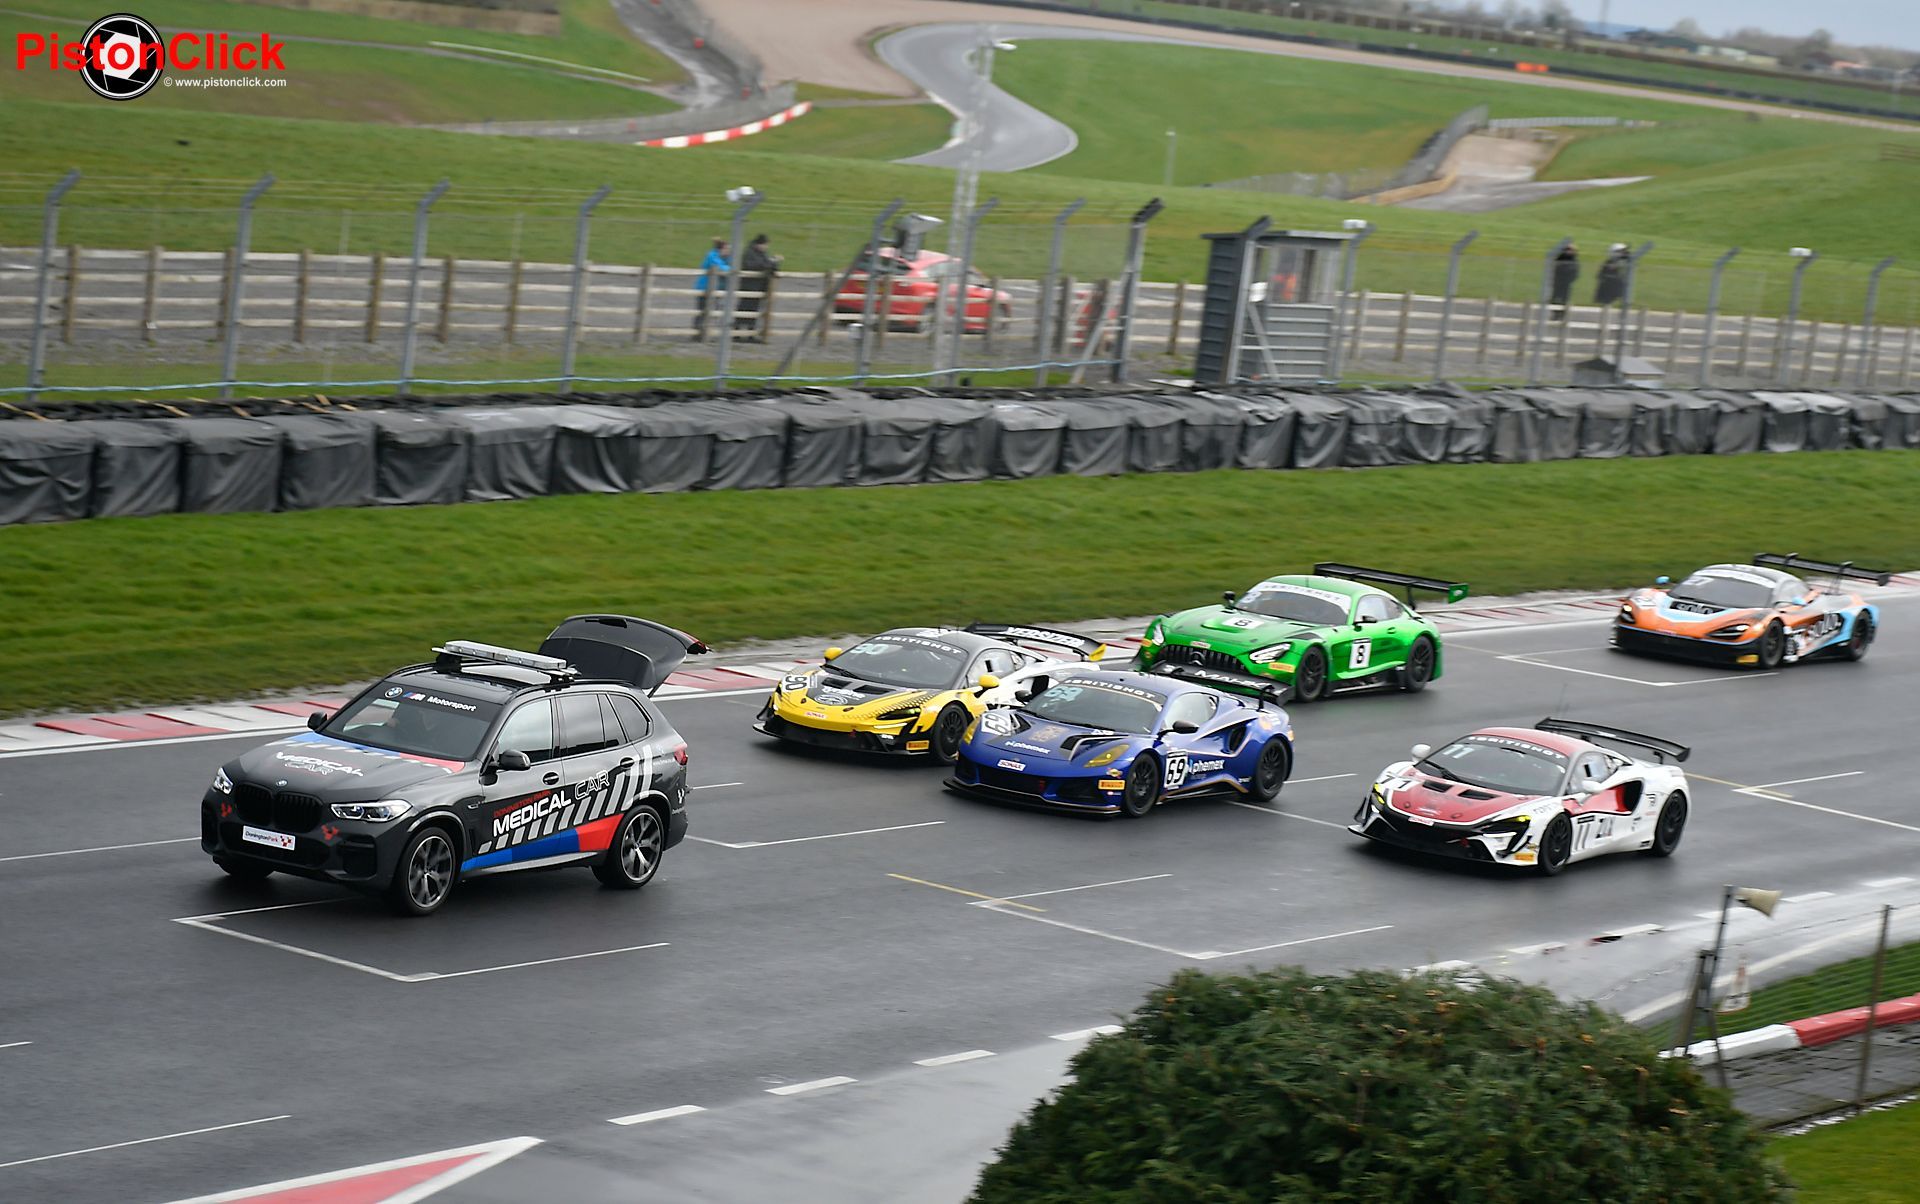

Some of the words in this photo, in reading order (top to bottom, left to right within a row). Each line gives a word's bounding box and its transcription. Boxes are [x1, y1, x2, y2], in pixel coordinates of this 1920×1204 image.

[850, 643, 889, 655] 90
[1356, 644, 1366, 664] 8
[1044, 685, 1084, 701] 69
[427, 696, 477, 712] Motorsport
[276, 752, 363, 777] MEDICAL
[1166, 759, 1185, 784] 69
[1193, 760, 1225, 774] phemex
[493, 790, 572, 837] MEDICAL
[574, 770, 610, 800] CAR
